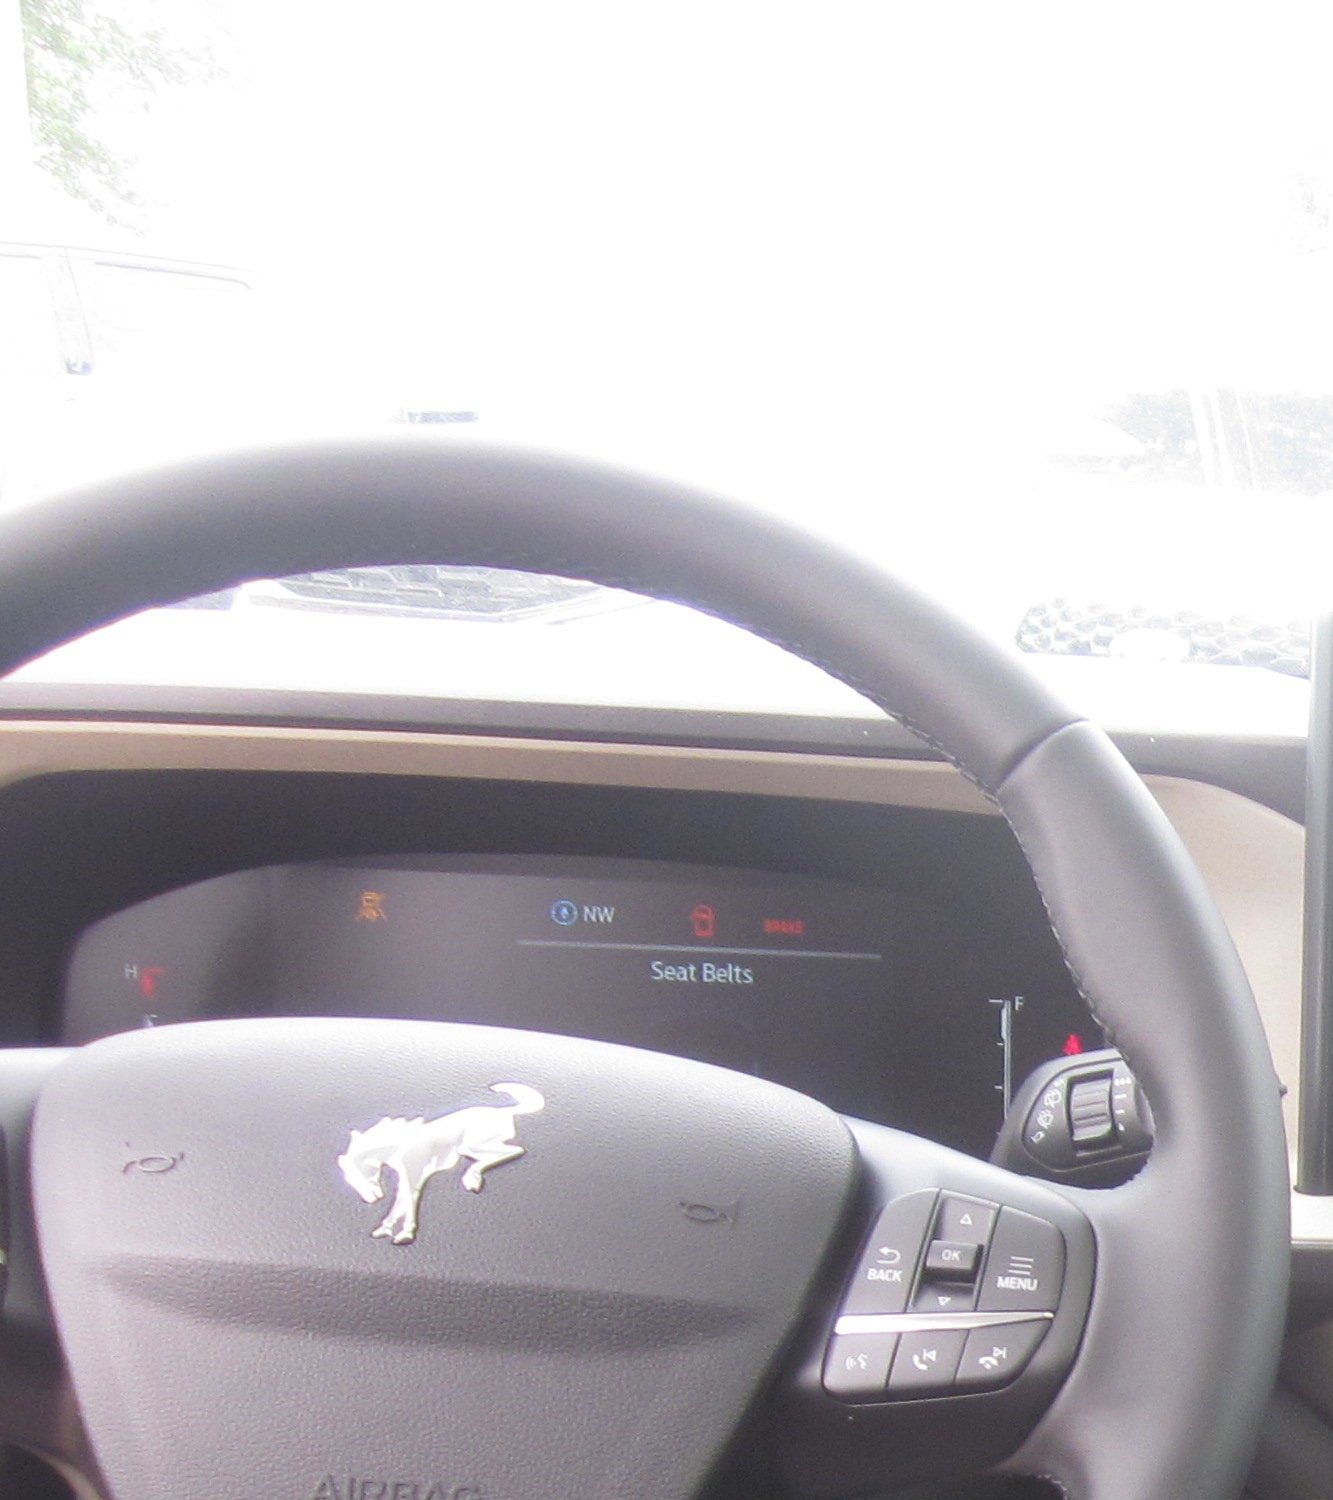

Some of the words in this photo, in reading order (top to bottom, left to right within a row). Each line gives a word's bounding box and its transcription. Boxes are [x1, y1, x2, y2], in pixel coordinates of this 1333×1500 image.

[583, 906, 615, 924] NW
[124, 964, 138, 979] H
[651, 960, 697, 983] Seat
[702, 962, 754, 985] Belts
[1014, 997, 1025, 1011] F
[942, 1249, 962, 1262] OK
[867, 1269, 903, 1283] BACK
[997, 1276, 1038, 1291] MENU
